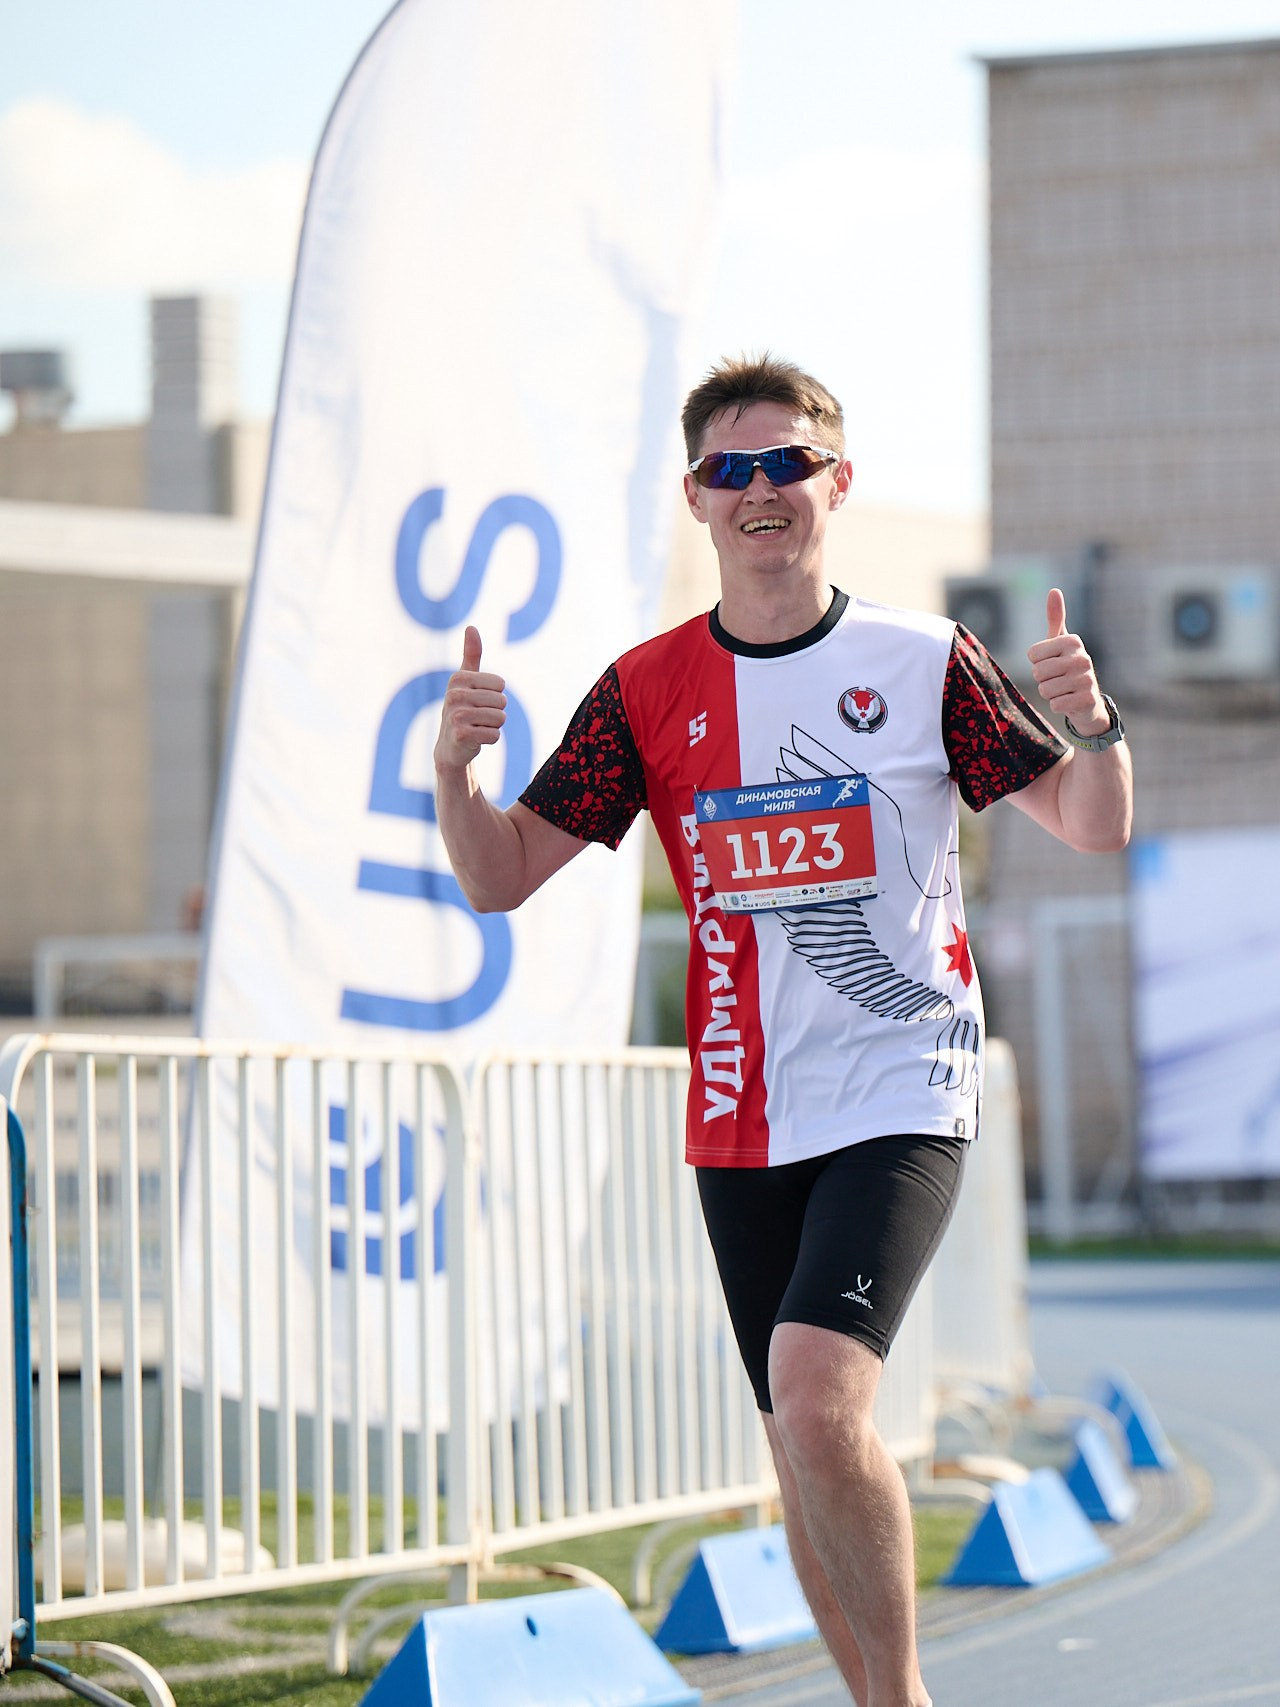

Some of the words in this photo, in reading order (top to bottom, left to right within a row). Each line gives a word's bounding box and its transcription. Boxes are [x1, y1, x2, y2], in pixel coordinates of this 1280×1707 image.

[339, 485, 564, 1033] UDS
[736, 785, 822, 806] ДИНАМОВСКАЯ
[763, 800, 796, 813] МИЛЯ
[725, 822, 845, 880] 1123
